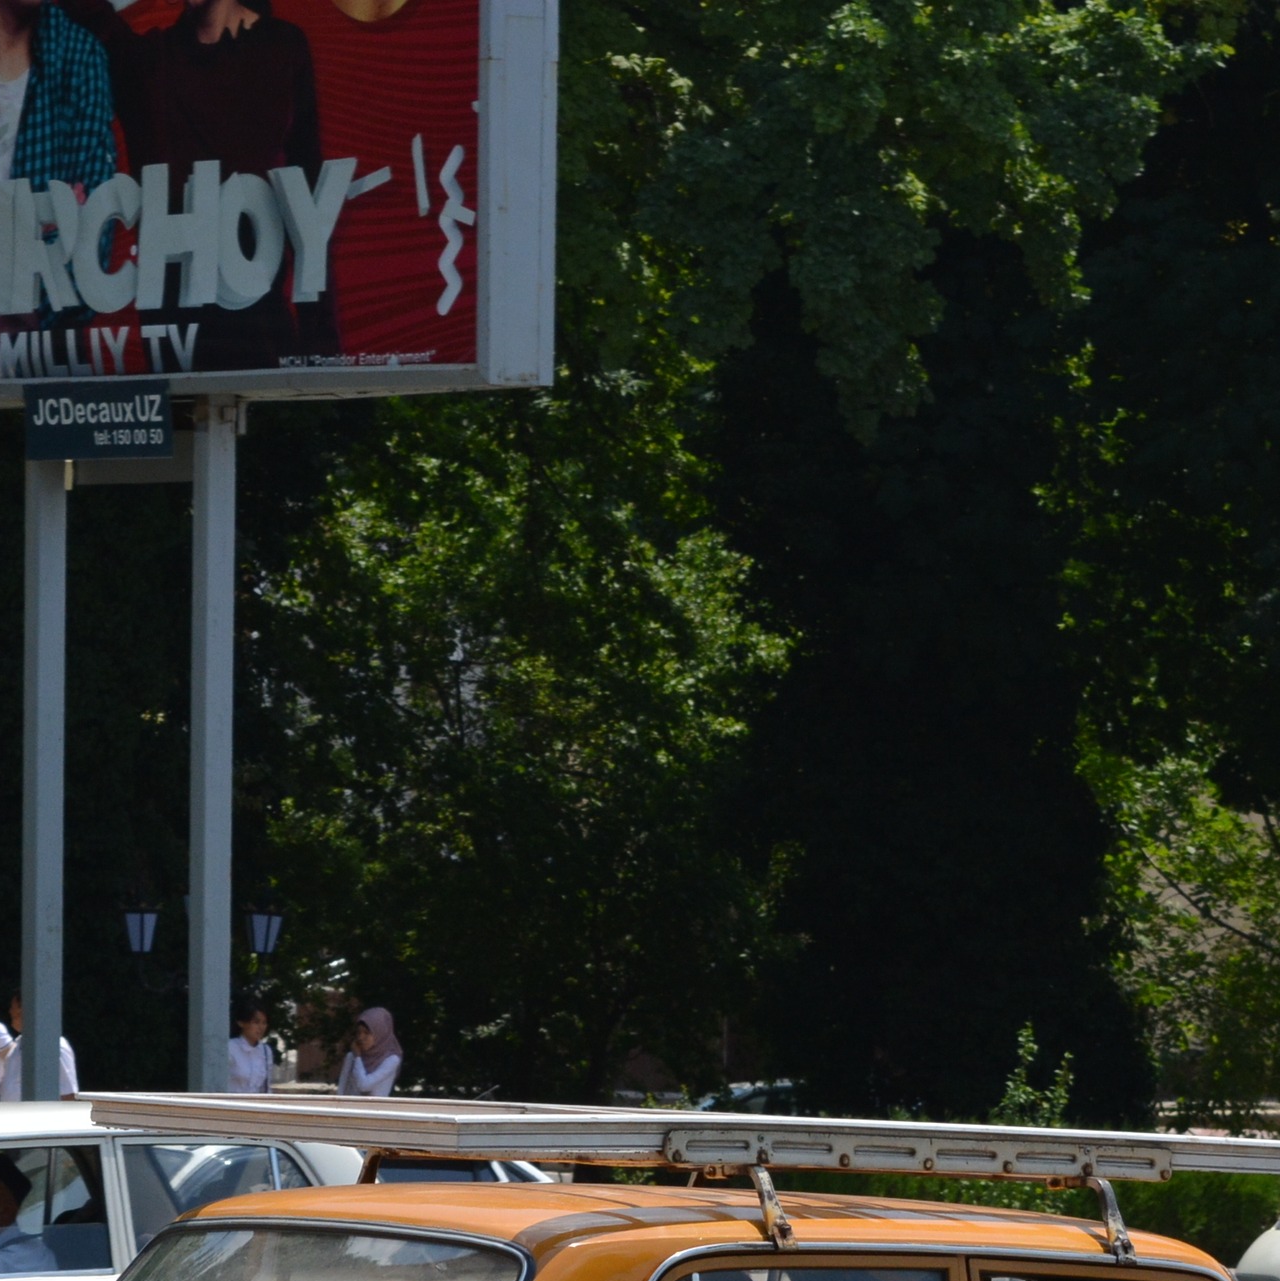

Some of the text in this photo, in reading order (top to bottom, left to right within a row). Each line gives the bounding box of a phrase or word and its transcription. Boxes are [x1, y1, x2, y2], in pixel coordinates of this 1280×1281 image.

[0, 323, 199, 378] MILLIY TV
[33, 395, 163, 425] JCDecauxUZ
[133, 429, 147, 444] 00
[149, 429, 163, 444] 50
